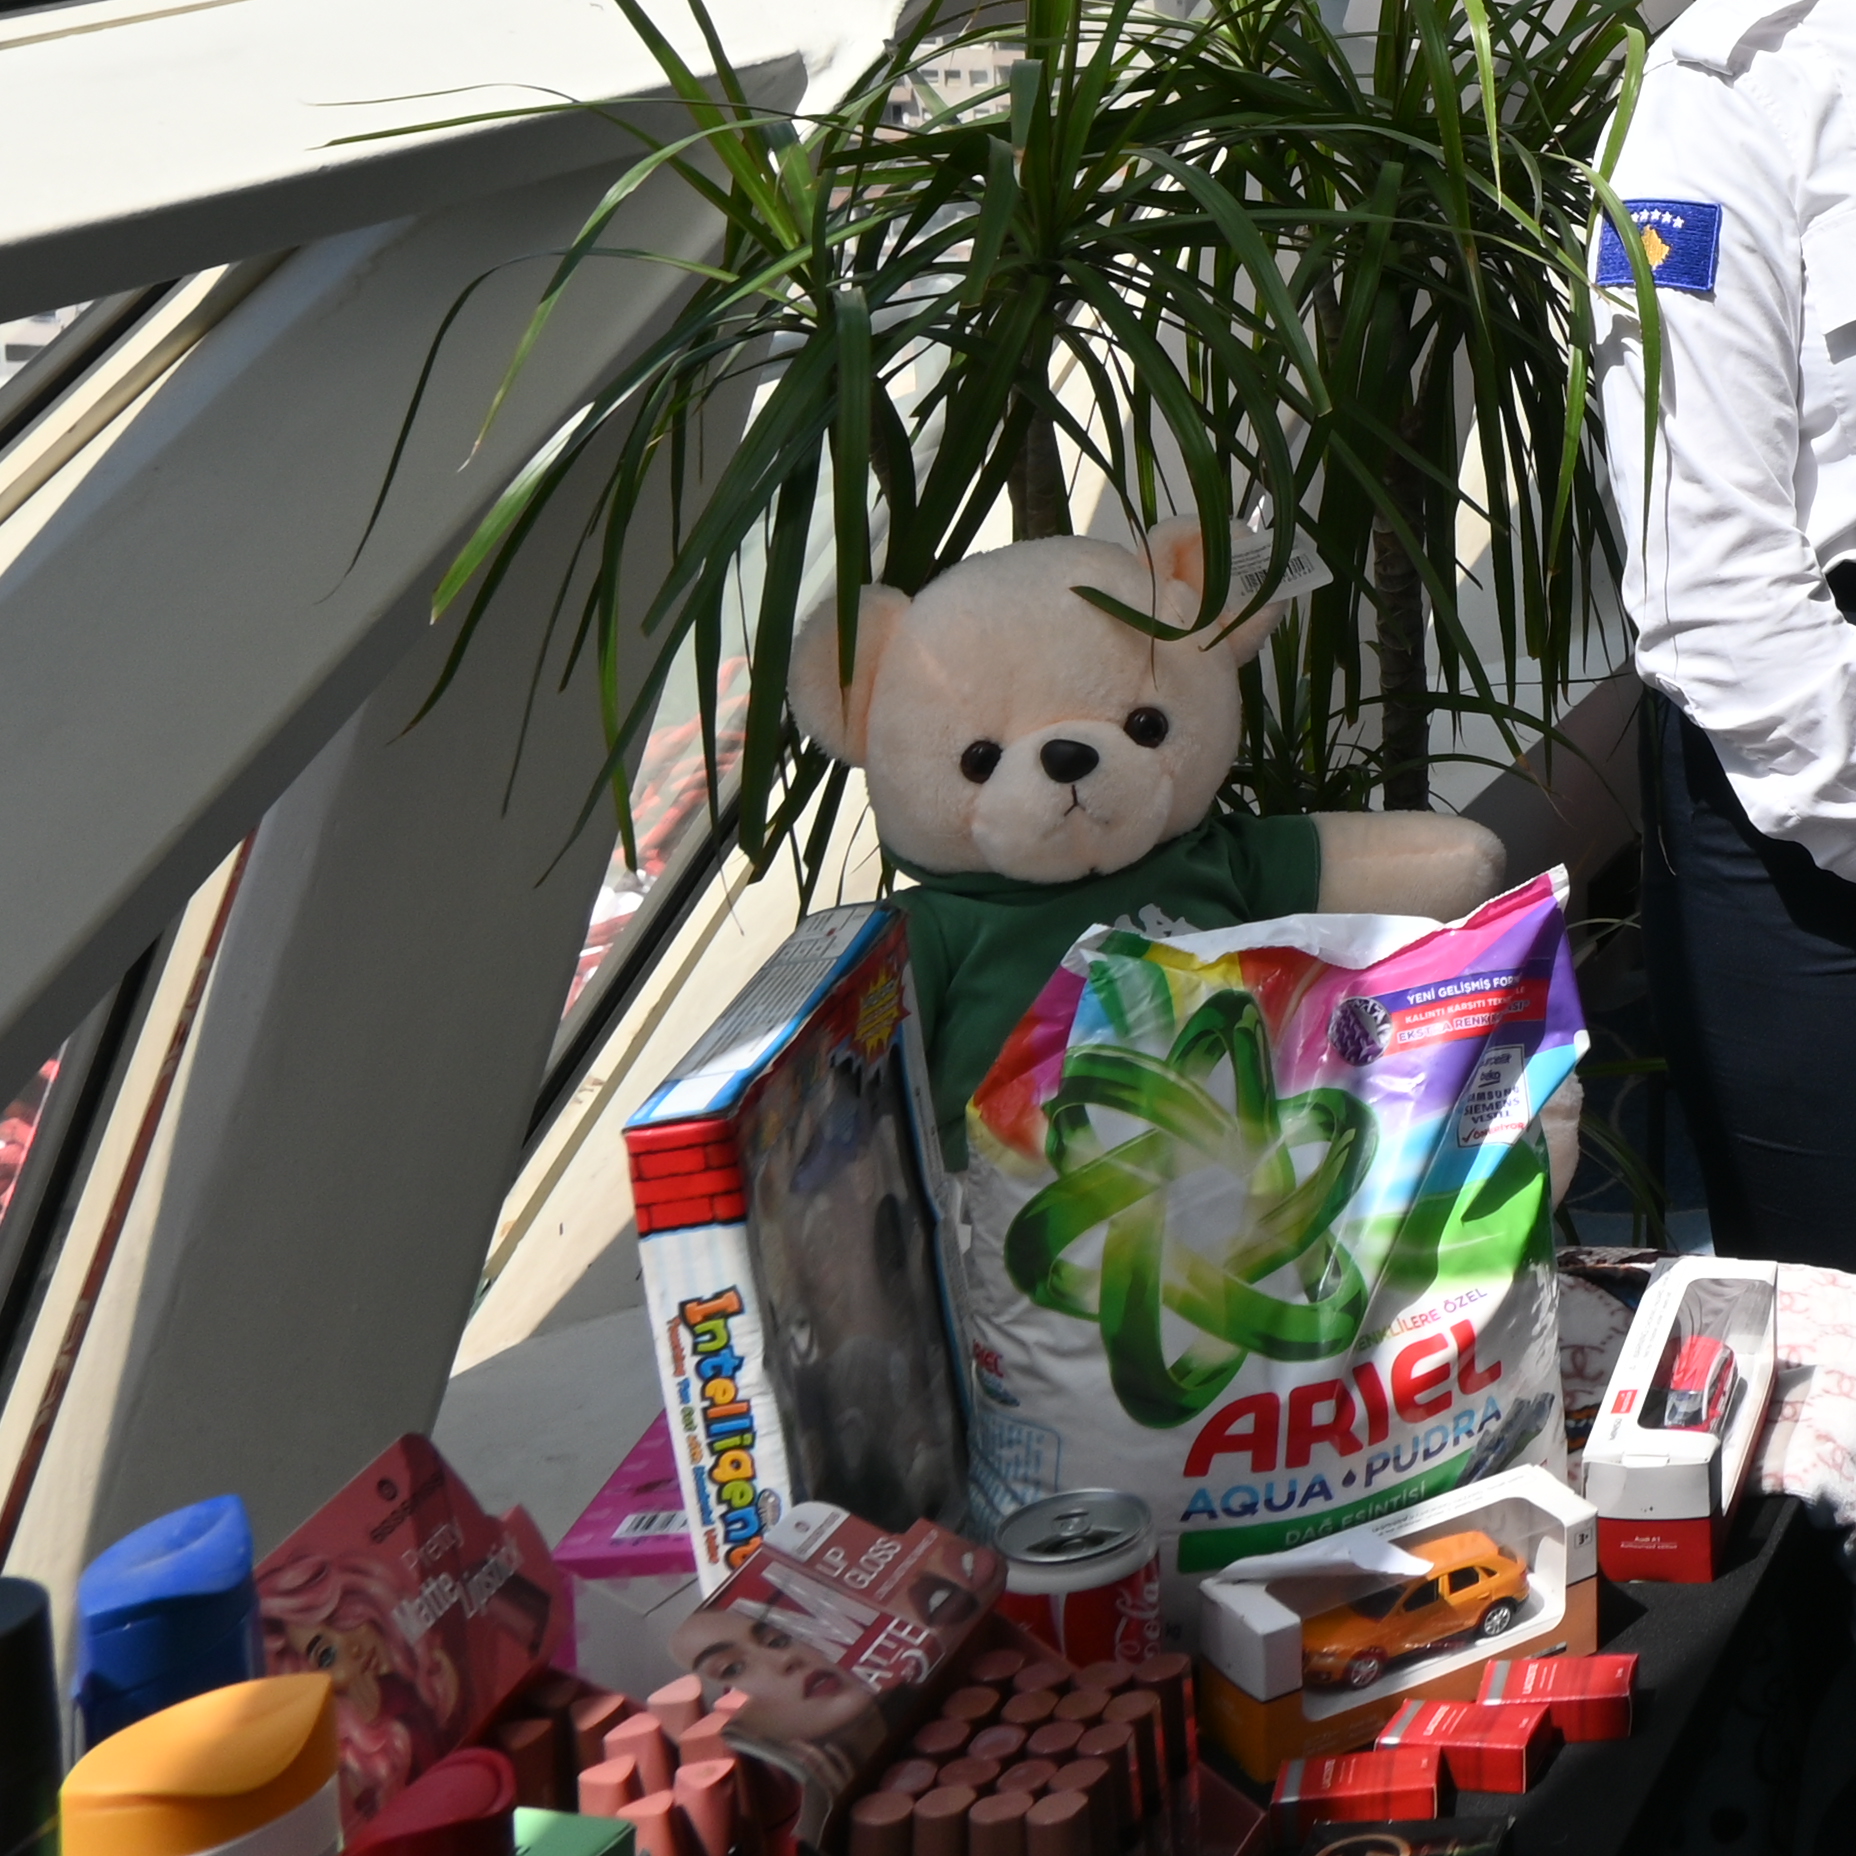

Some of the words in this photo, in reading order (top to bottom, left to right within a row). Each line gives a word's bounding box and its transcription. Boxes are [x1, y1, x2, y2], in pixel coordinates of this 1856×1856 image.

[1407, 988, 1436, 1005] YENİ
[1438, 976, 1492, 998] GELİŞMİŞ
[1405, 1006, 1446, 1024] KALINTI
[1447, 999, 1486, 1016] KARŞITI
[1453, 1013, 1491, 1030] RENK
[1464, 1098, 1520, 1116] SIEMENS
[1355, 1308, 1442, 1352] ENKLİLERE
[1443, 1287, 1488, 1313] ÖZEL
[1183, 1319, 1502, 1477] ARIEL
[1179, 1472, 1333, 1522] AQUA
[1363, 1396, 1502, 1488] PUDRA
[1285, 1516, 1333, 1546] DAĞ
[815, 1546, 848, 1577] LIP
[843, 1535, 902, 1590] GLOSS
[392, 1571, 460, 1644] Matte
